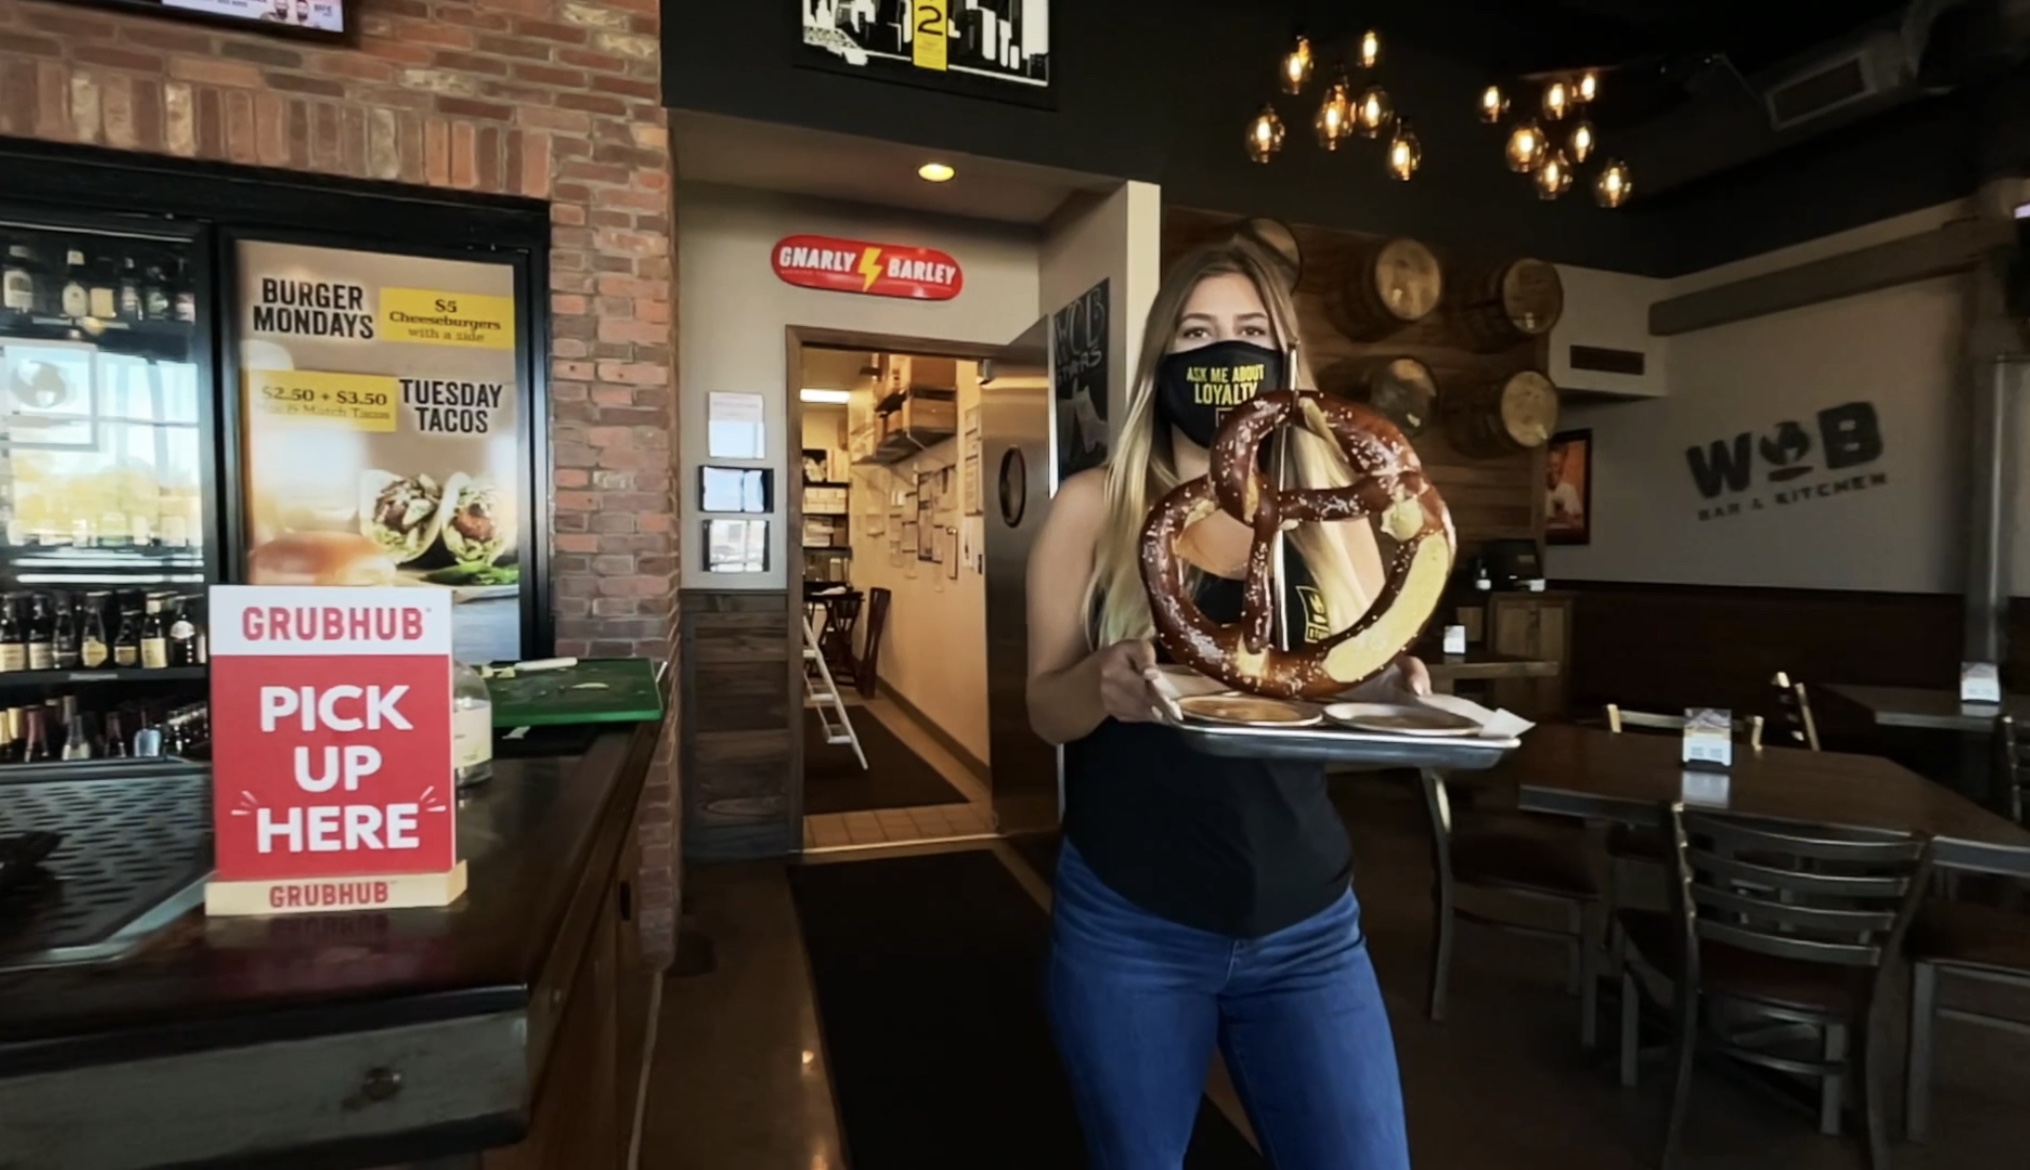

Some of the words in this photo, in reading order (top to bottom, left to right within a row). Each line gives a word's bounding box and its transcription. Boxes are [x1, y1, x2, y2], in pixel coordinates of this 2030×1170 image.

[917, 5, 943, 37] 2
[778, 246, 857, 273] GNARLY
[887, 257, 956, 285] BARLEY
[262, 278, 363, 310] BURGER
[253, 305, 374, 339] MONDAYS
[389, 310, 501, 331] Cheeseburgers
[408, 328, 439, 339] with
[443, 332, 451, 340] a
[1186, 366, 1208, 382] ASK
[1210, 367, 1228, 383] ME
[1232, 364, 1264, 382] ABOUT
[336, 390, 388, 406] $3.50
[399, 378, 502, 408] TUESDAY
[1194, 381, 1258, 405] LOYALTY
[414, 406, 488, 433] TACOS
[1775, 473, 1887, 505] KITCHEN
[242, 606, 423, 641] GRUBHUB
[260, 684, 414, 732] PICK
[294, 744, 382, 793] UP
[257, 803, 420, 853] HERE
[269, 881, 389, 907] GRUBHUB
